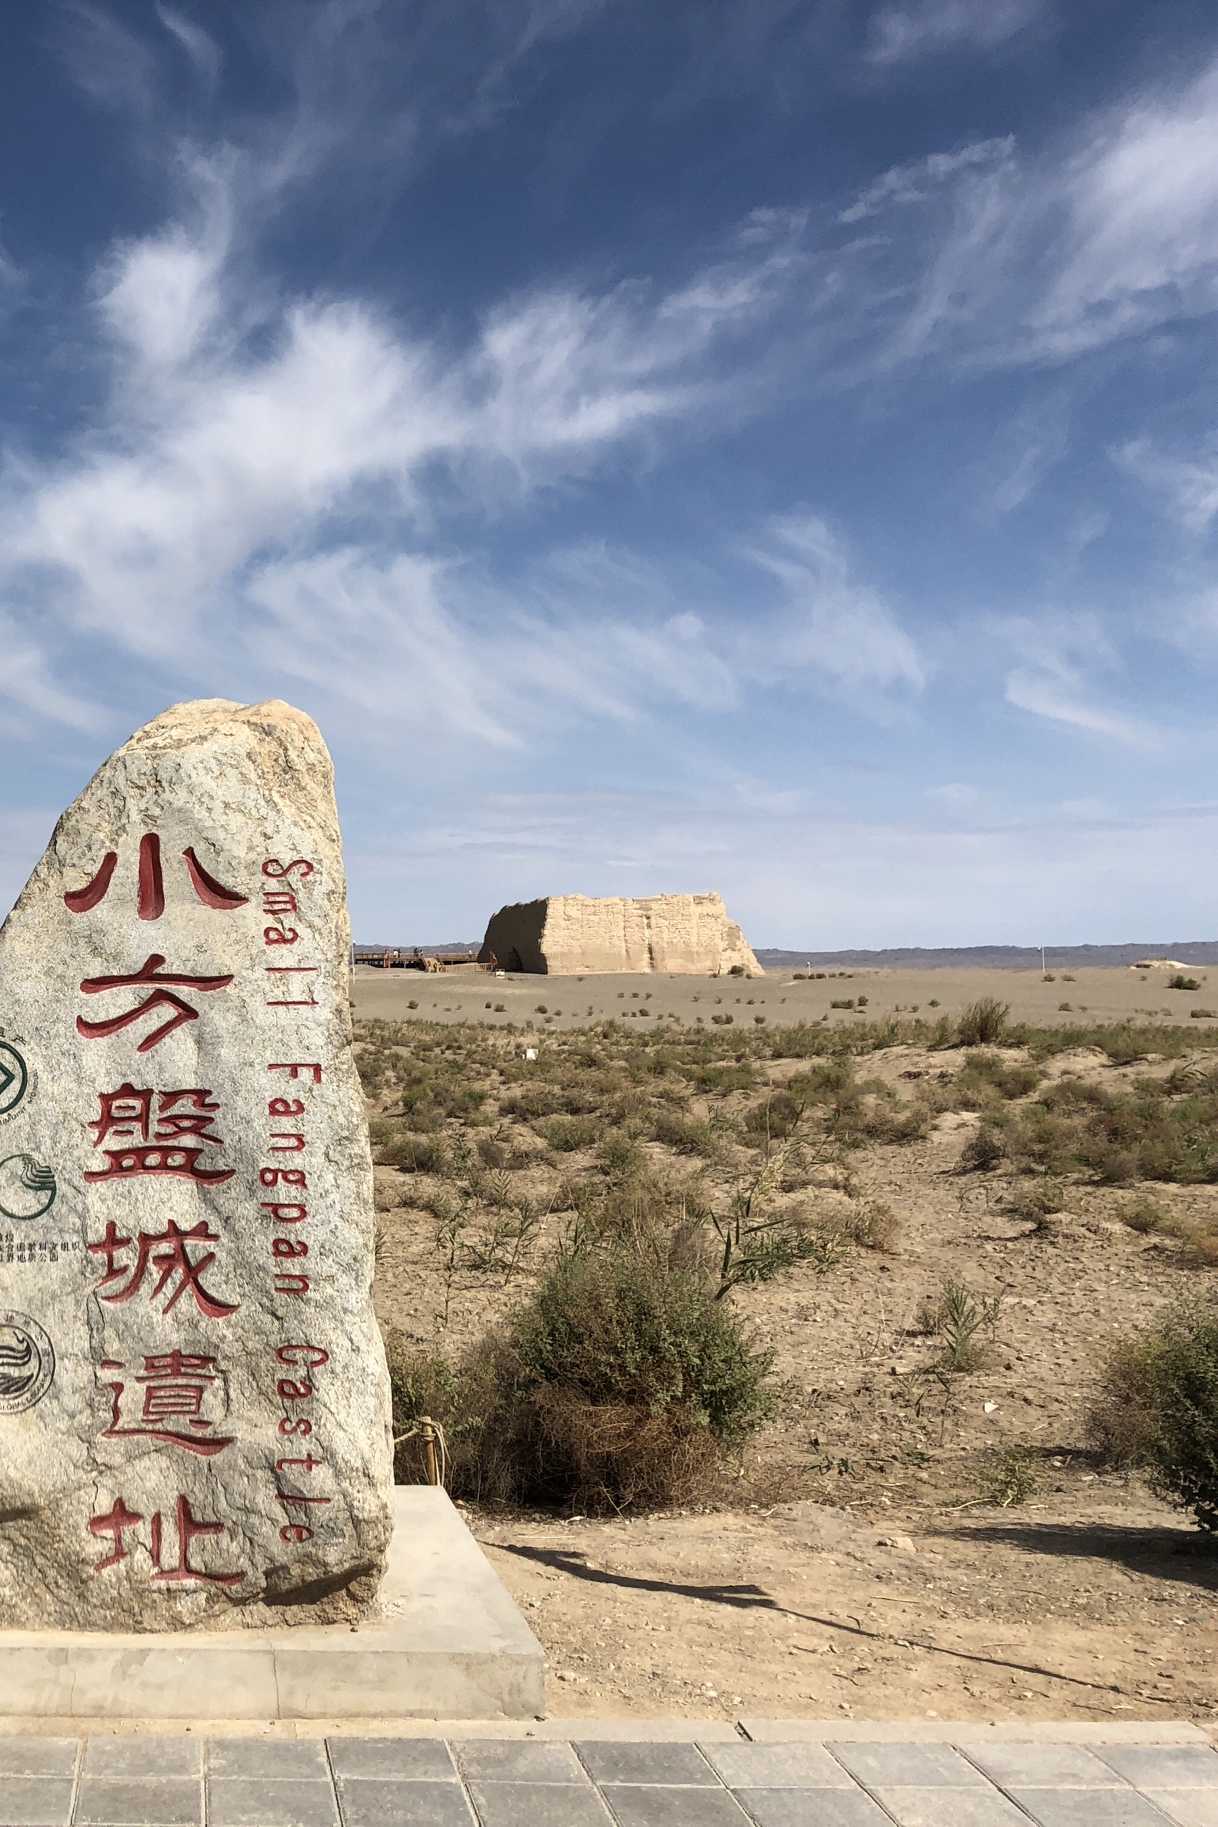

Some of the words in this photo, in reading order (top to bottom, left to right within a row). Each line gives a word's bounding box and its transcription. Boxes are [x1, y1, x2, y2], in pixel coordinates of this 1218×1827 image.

[262, 858, 319, 1006] Small
[64, 832, 249, 1586] 小方盤城遺址
[259, 1063, 322, 1294] Fangpan
[275, 1345, 331, 1544] Castle
